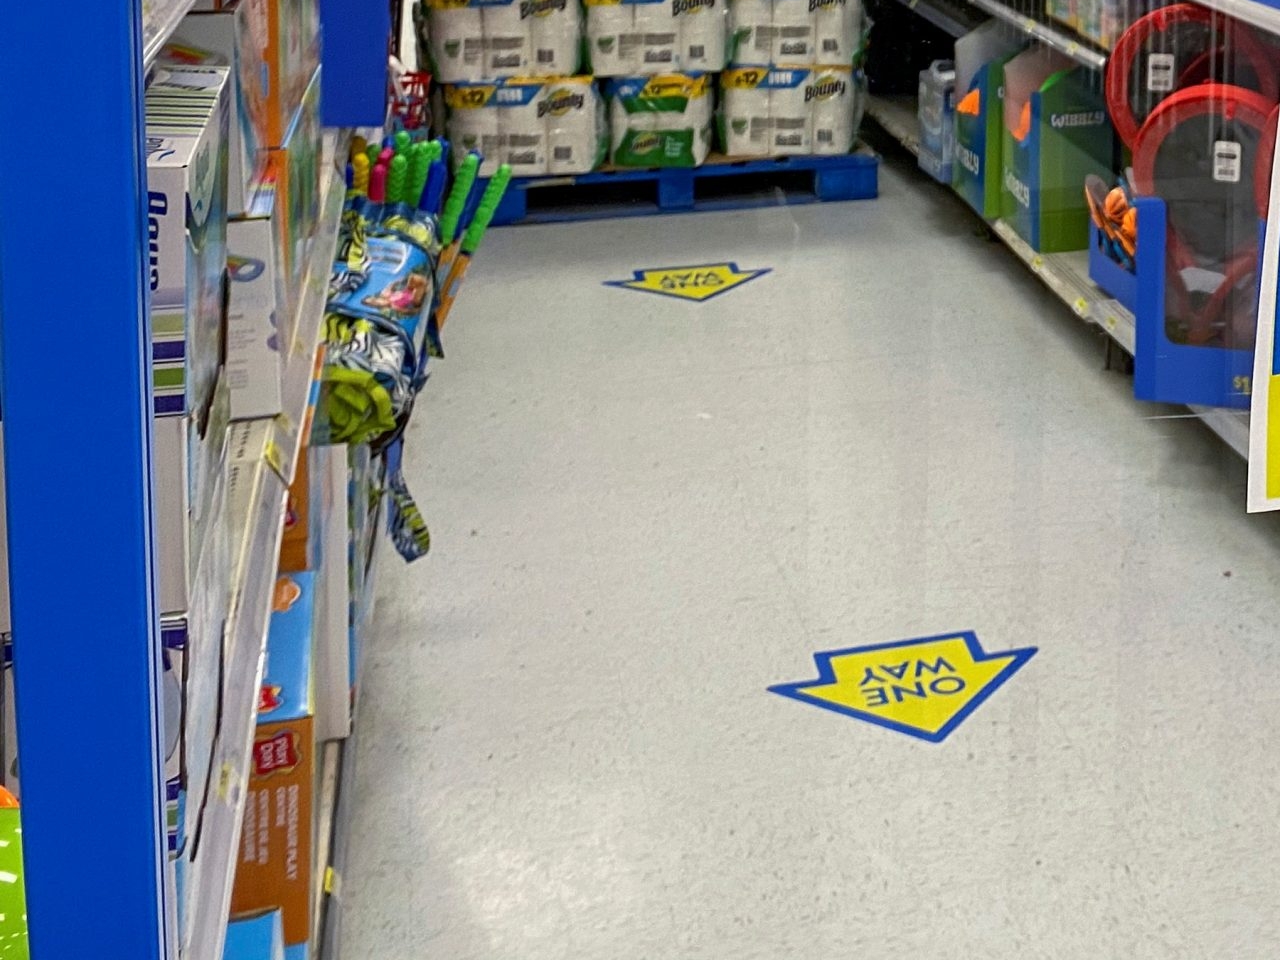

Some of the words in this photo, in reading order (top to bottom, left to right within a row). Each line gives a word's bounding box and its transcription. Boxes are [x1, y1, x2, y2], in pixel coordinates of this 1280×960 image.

[804, 80, 846, 102] Bounty
[537, 93, 584, 118] Bounty
[859, 656, 956, 687] WAY
[859, 675, 967, 708] ONE
